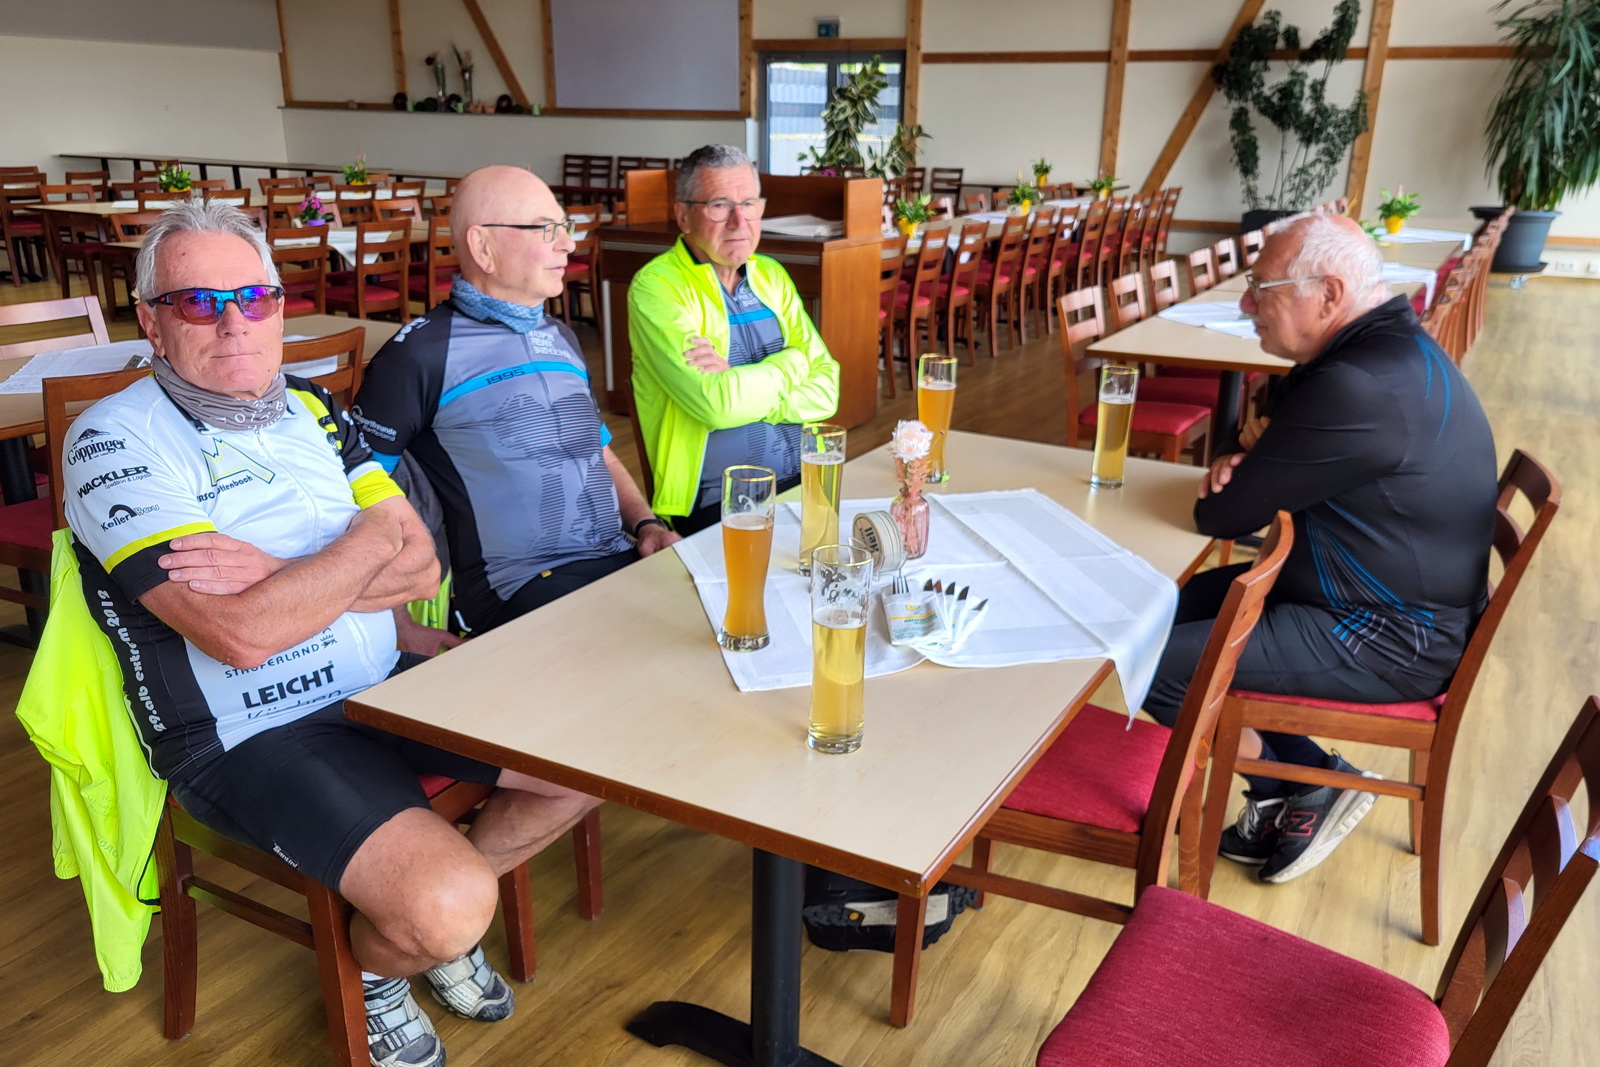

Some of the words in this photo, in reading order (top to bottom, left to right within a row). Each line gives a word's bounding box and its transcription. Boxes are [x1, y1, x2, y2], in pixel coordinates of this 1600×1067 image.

[486, 368, 526, 385] 1995
[67, 439, 126, 466] Göppinger
[77, 465, 149, 499] WACKLER
[104, 479, 127, 490] Spedition
[100, 513, 130, 532] Keller
[97, 589, 121, 627] 2012
[241, 664, 335, 710] LEICHT
